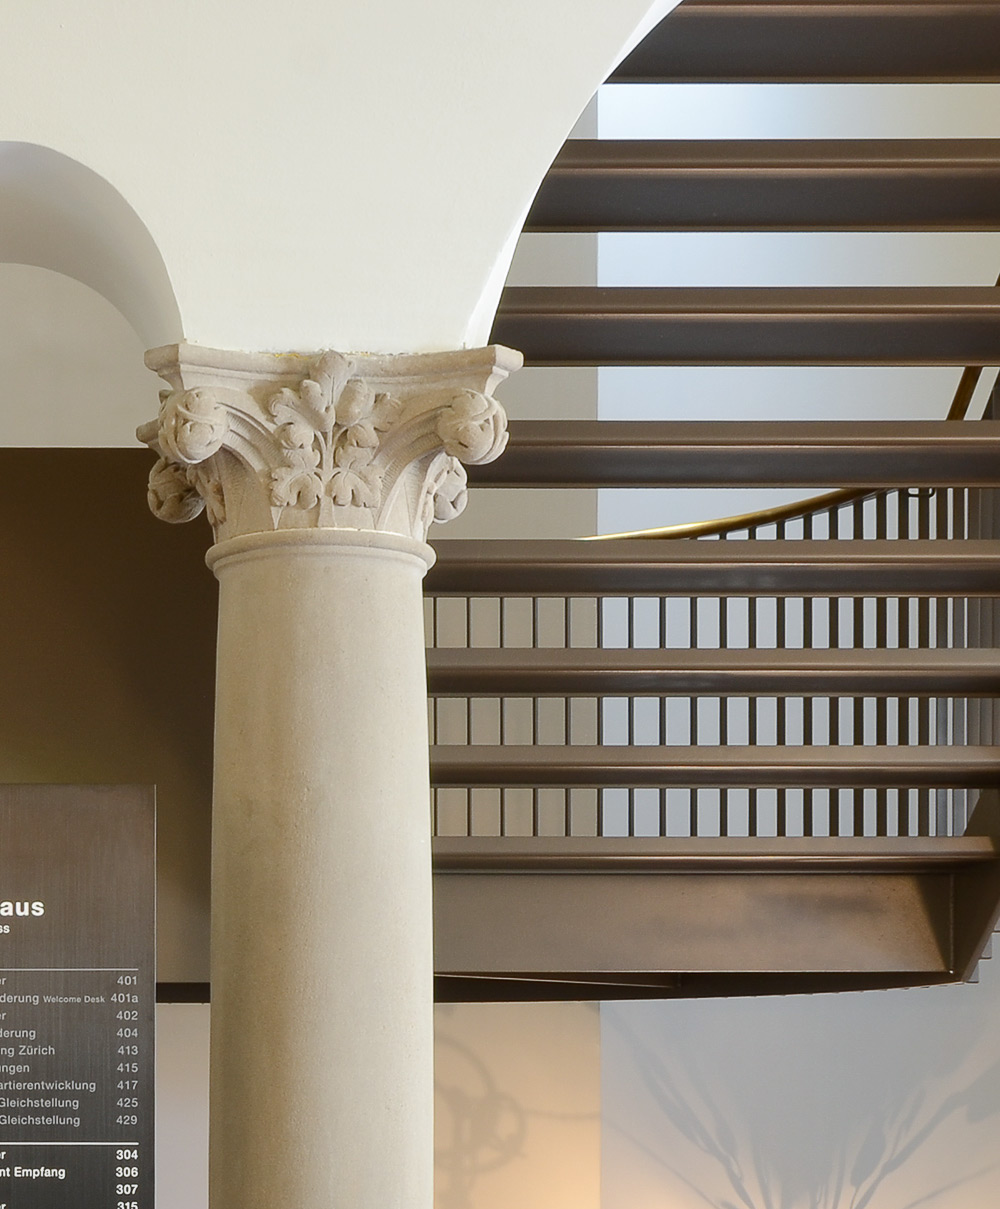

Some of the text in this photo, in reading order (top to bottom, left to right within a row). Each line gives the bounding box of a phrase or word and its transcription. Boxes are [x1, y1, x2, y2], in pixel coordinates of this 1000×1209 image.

[116, 976, 137, 986] 401
[42, 996, 82, 1004] Welcome
[83, 996, 106, 1004] Desk
[110, 993, 139, 1004] 401a
[115, 1011, 139, 1021] 402
[116, 1028, 139, 1039] 404
[18, 1045, 56, 1056] Zürich
[117, 1046, 139, 1056] 413
[116, 1063, 139, 1073] 415
[116, 1081, 139, 1091] 417
[116, 1098, 139, 1108] 425
[115, 1115, 138, 1125] 429
[115, 1149, 139, 1161] 304
[13, 1167, 66, 1180] Empfang
[115, 1167, 139, 1178] 306
[115, 1184, 139, 1195] 307
